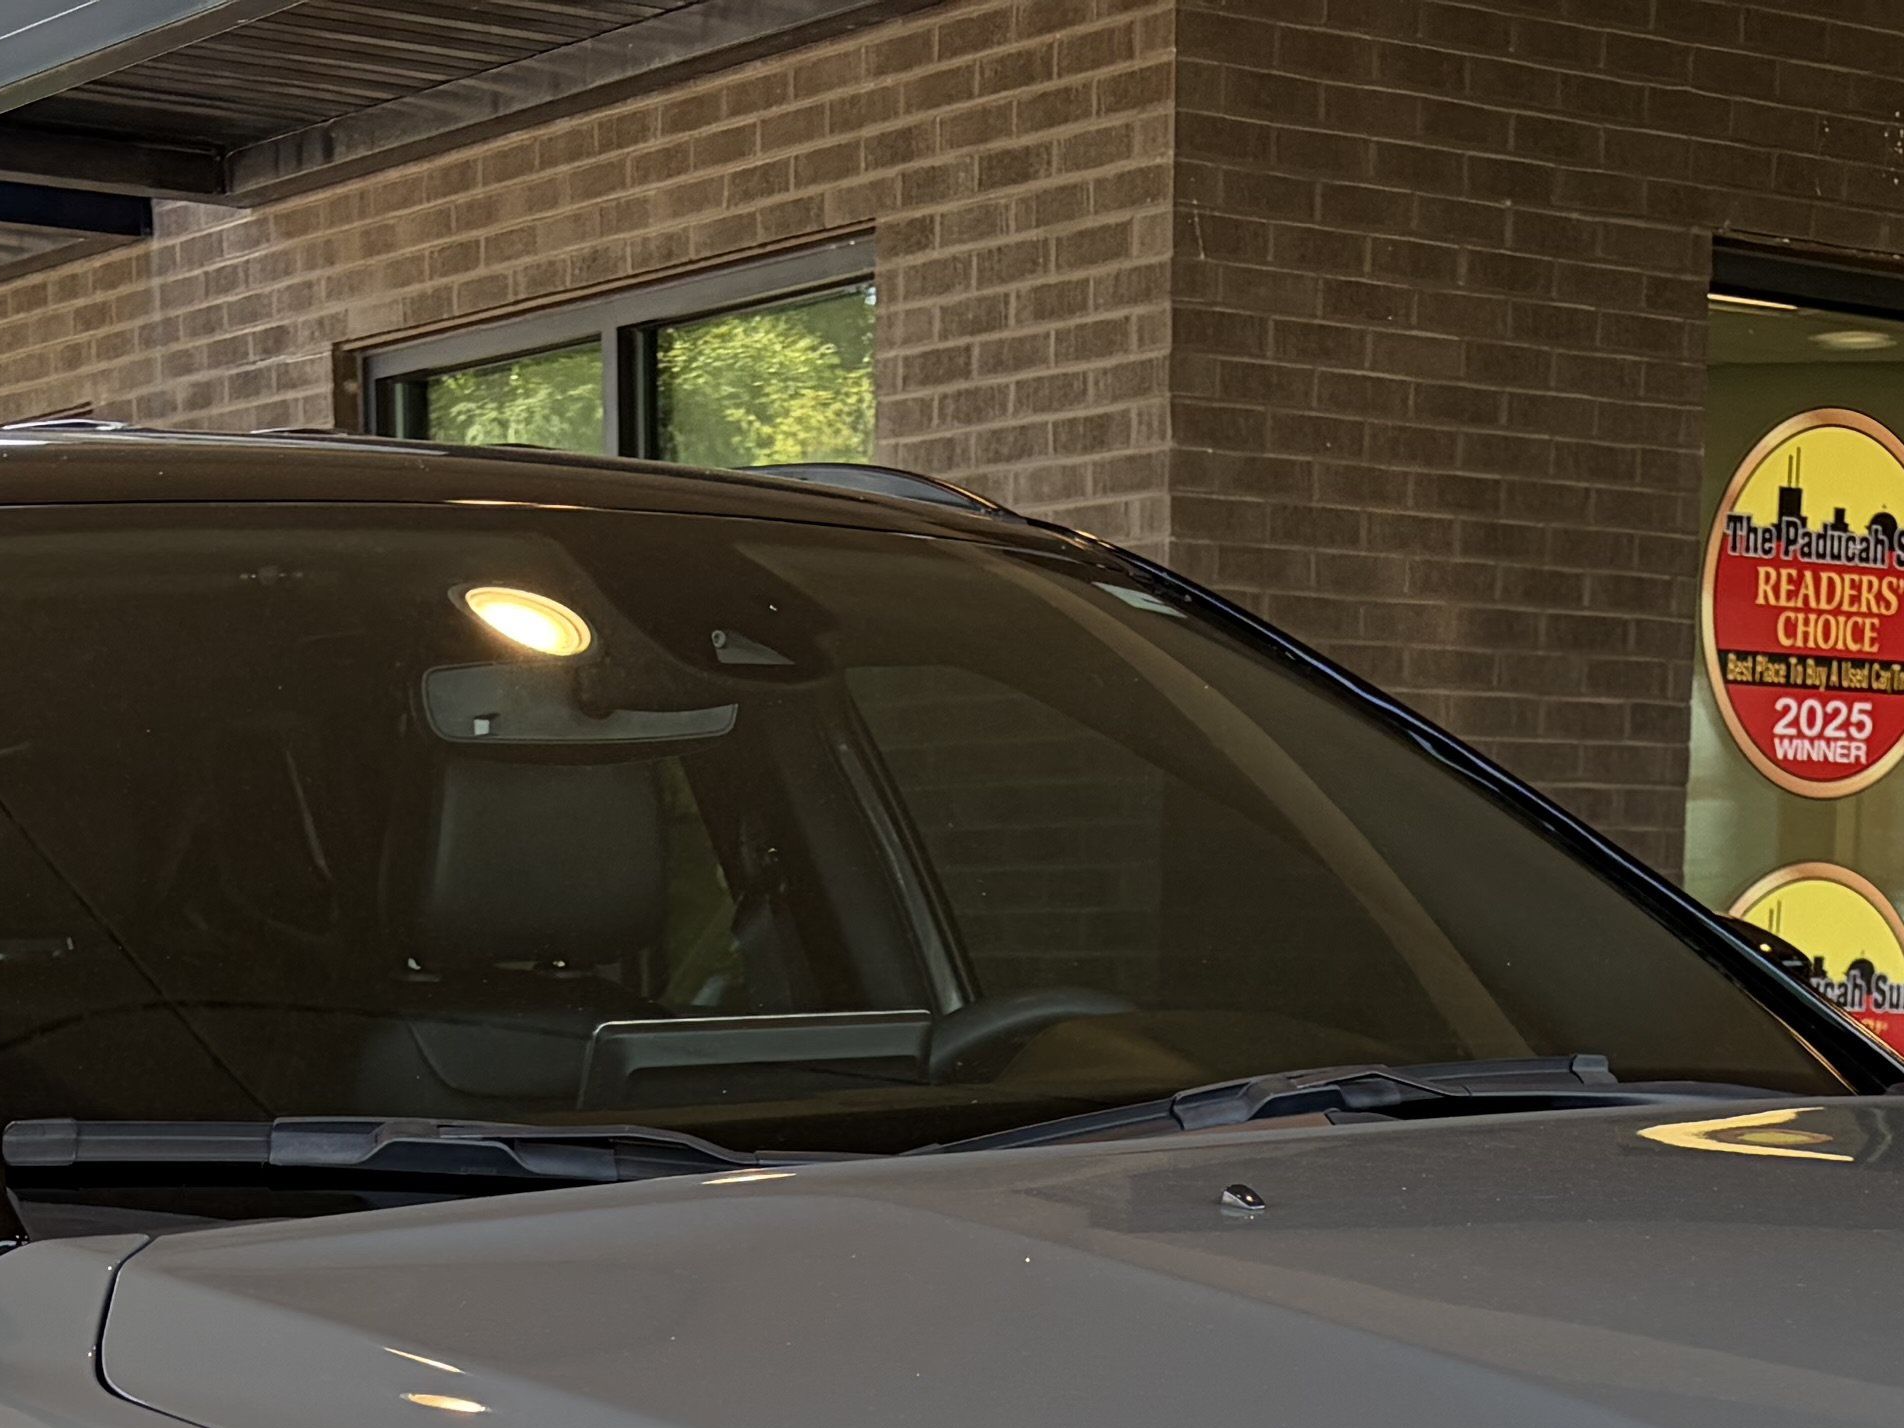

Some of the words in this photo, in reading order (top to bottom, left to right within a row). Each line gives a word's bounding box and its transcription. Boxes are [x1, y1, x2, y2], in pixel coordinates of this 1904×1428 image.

[1726, 513, 1779, 558] The
[1781, 517, 1888, 567] Paducah
[1776, 611, 1880, 653] CHOICE
[1727, 653, 1753, 682] Best
[1755, 654, 1786, 683] Place
[1789, 656, 1803, 684] To
[1806, 658, 1827, 692] Buy
[1830, 659, 1839, 687] A
[1842, 661, 1869, 689] Used
[1773, 697, 1872, 740] 2025
[1773, 737, 1867, 765] WINNER
